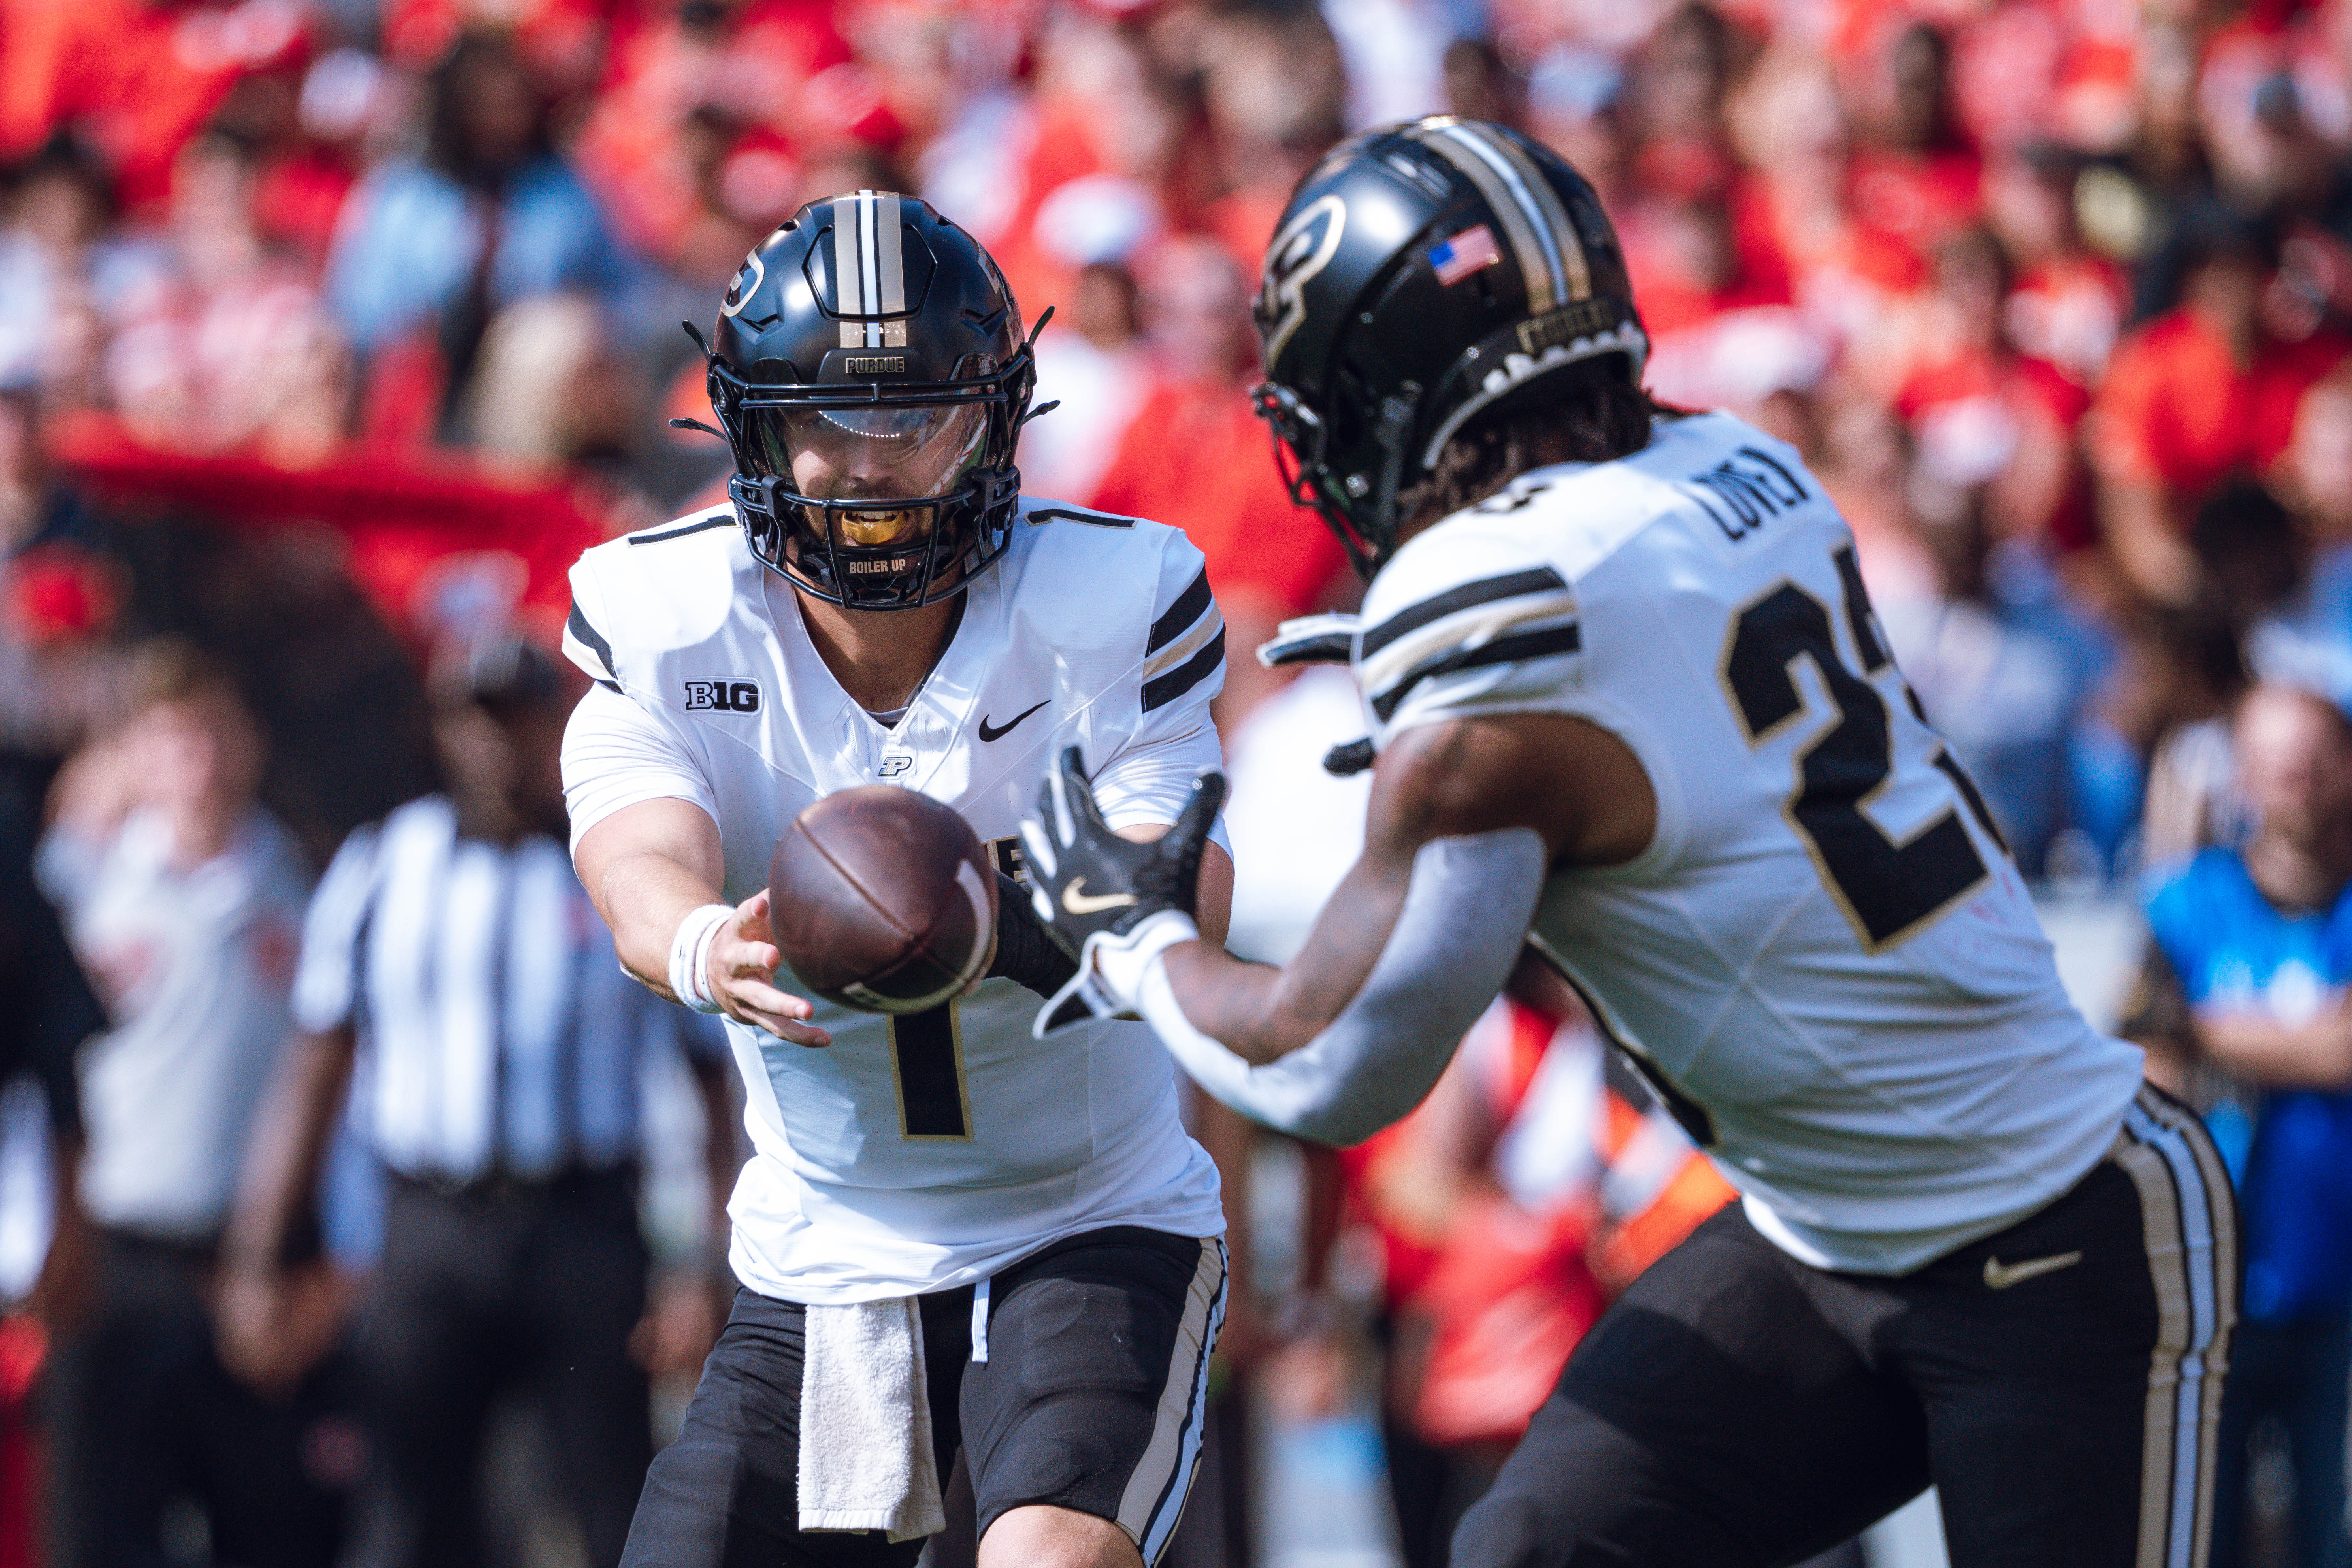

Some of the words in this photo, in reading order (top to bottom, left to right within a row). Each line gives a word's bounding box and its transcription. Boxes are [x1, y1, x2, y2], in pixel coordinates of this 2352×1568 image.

[846, 357, 905, 373] PURDUE
[850, 560, 888, 574] BOILER
[891, 559, 906, 571] UP
[1716, 533, 2015, 957] 2
[878, 756, 912, 776] P
